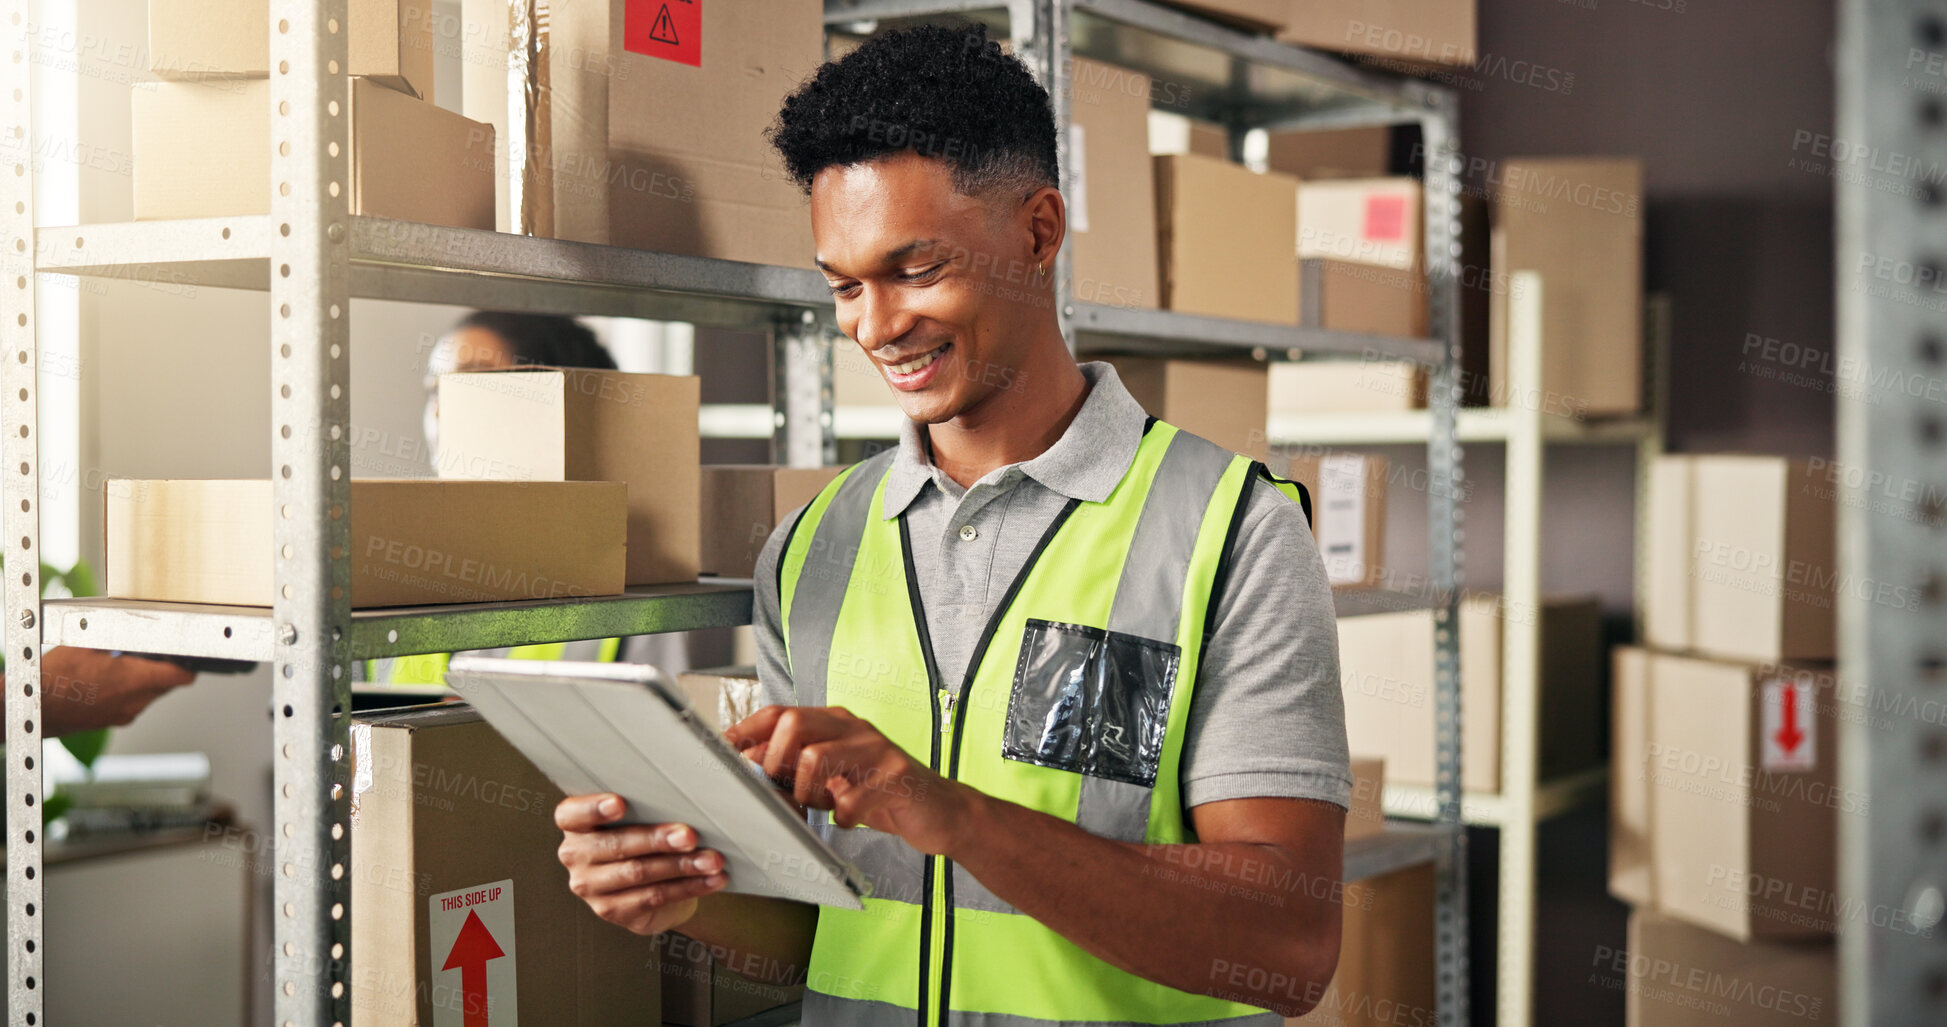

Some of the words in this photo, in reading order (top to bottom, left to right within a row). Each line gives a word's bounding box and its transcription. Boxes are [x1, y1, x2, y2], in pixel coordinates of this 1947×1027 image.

[440, 895, 463, 911] THIS
[465, 890, 487, 907] SIDE
[489, 887, 502, 902] UP
